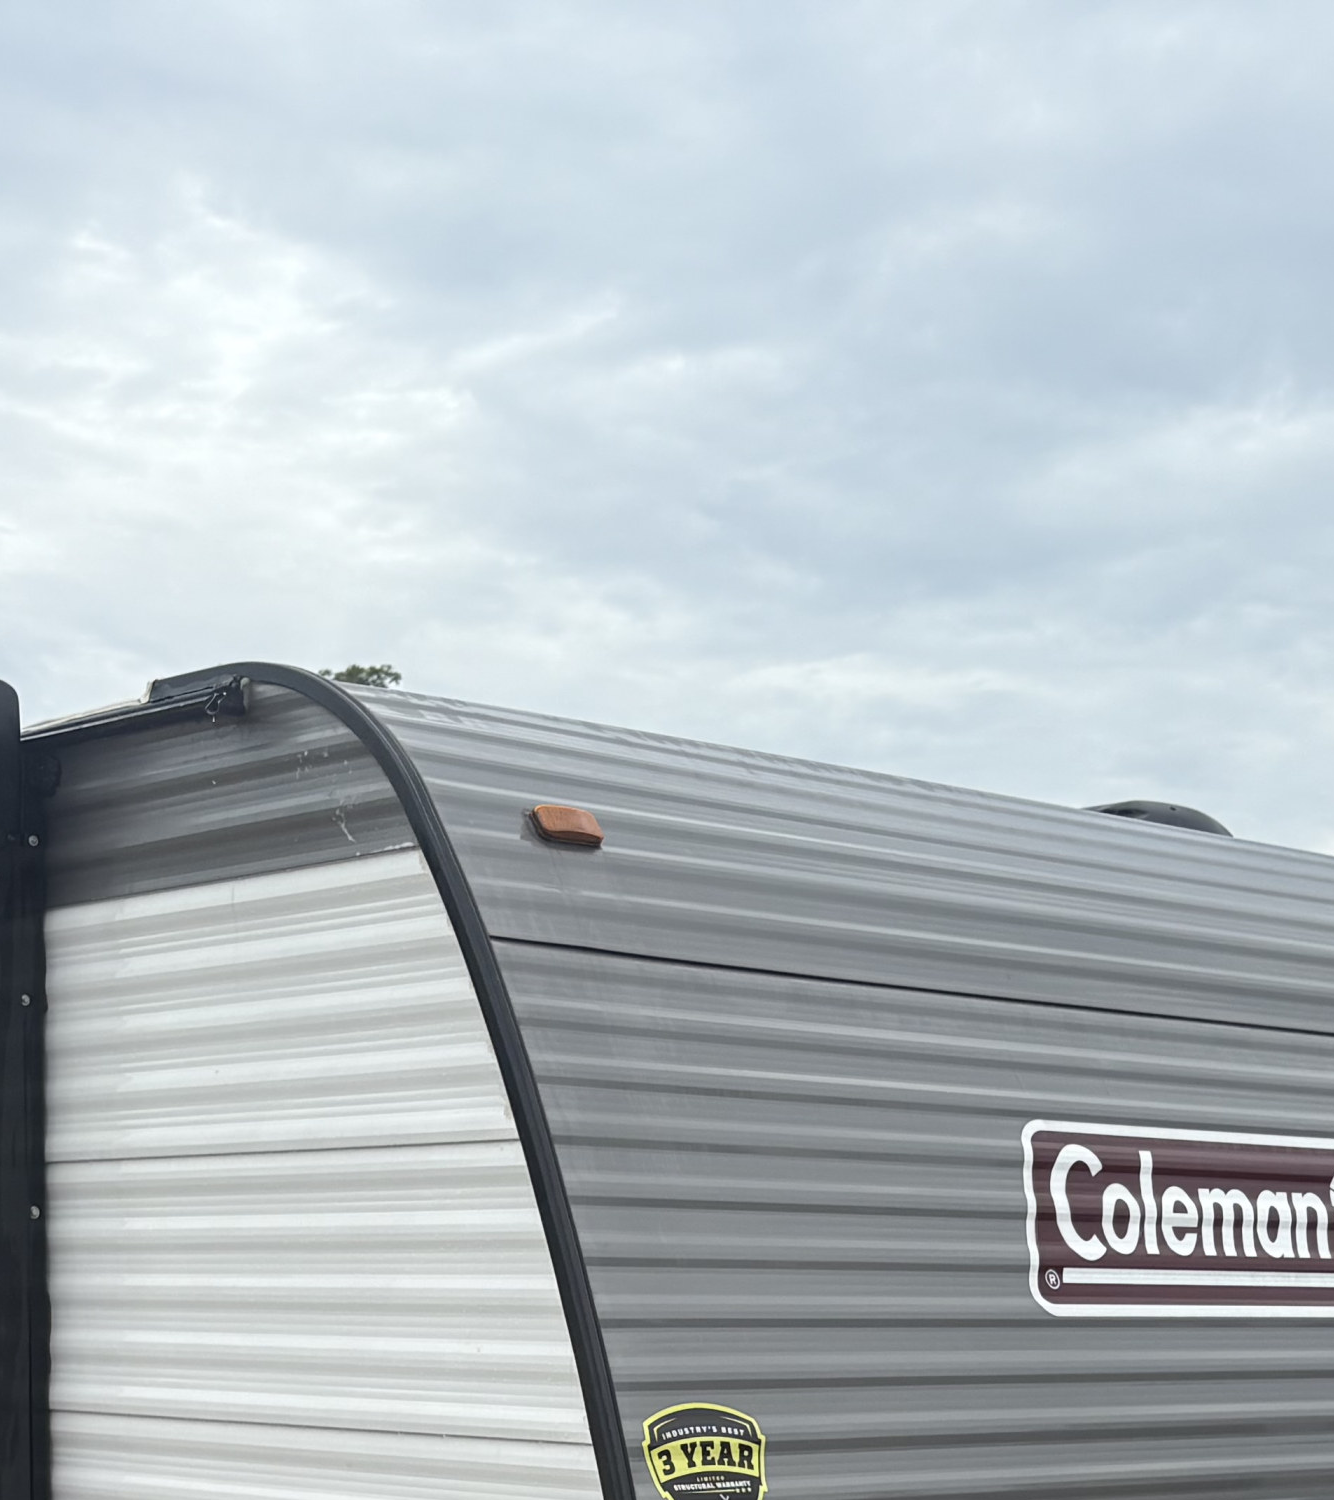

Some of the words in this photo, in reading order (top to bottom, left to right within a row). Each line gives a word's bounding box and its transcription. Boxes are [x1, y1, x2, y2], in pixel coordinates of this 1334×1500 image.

[1049, 1143, 1332, 1262] Coleman
[661, 1425, 718, 1440] INDUSTRY'S
[721, 1426, 745, 1436] BEST
[657, 1449, 676, 1476] 3
[680, 1440, 755, 1471] YEAR
[673, 1482, 715, 1491] STRUCTURAL
[715, 1480, 751, 1489] WARRANTY
